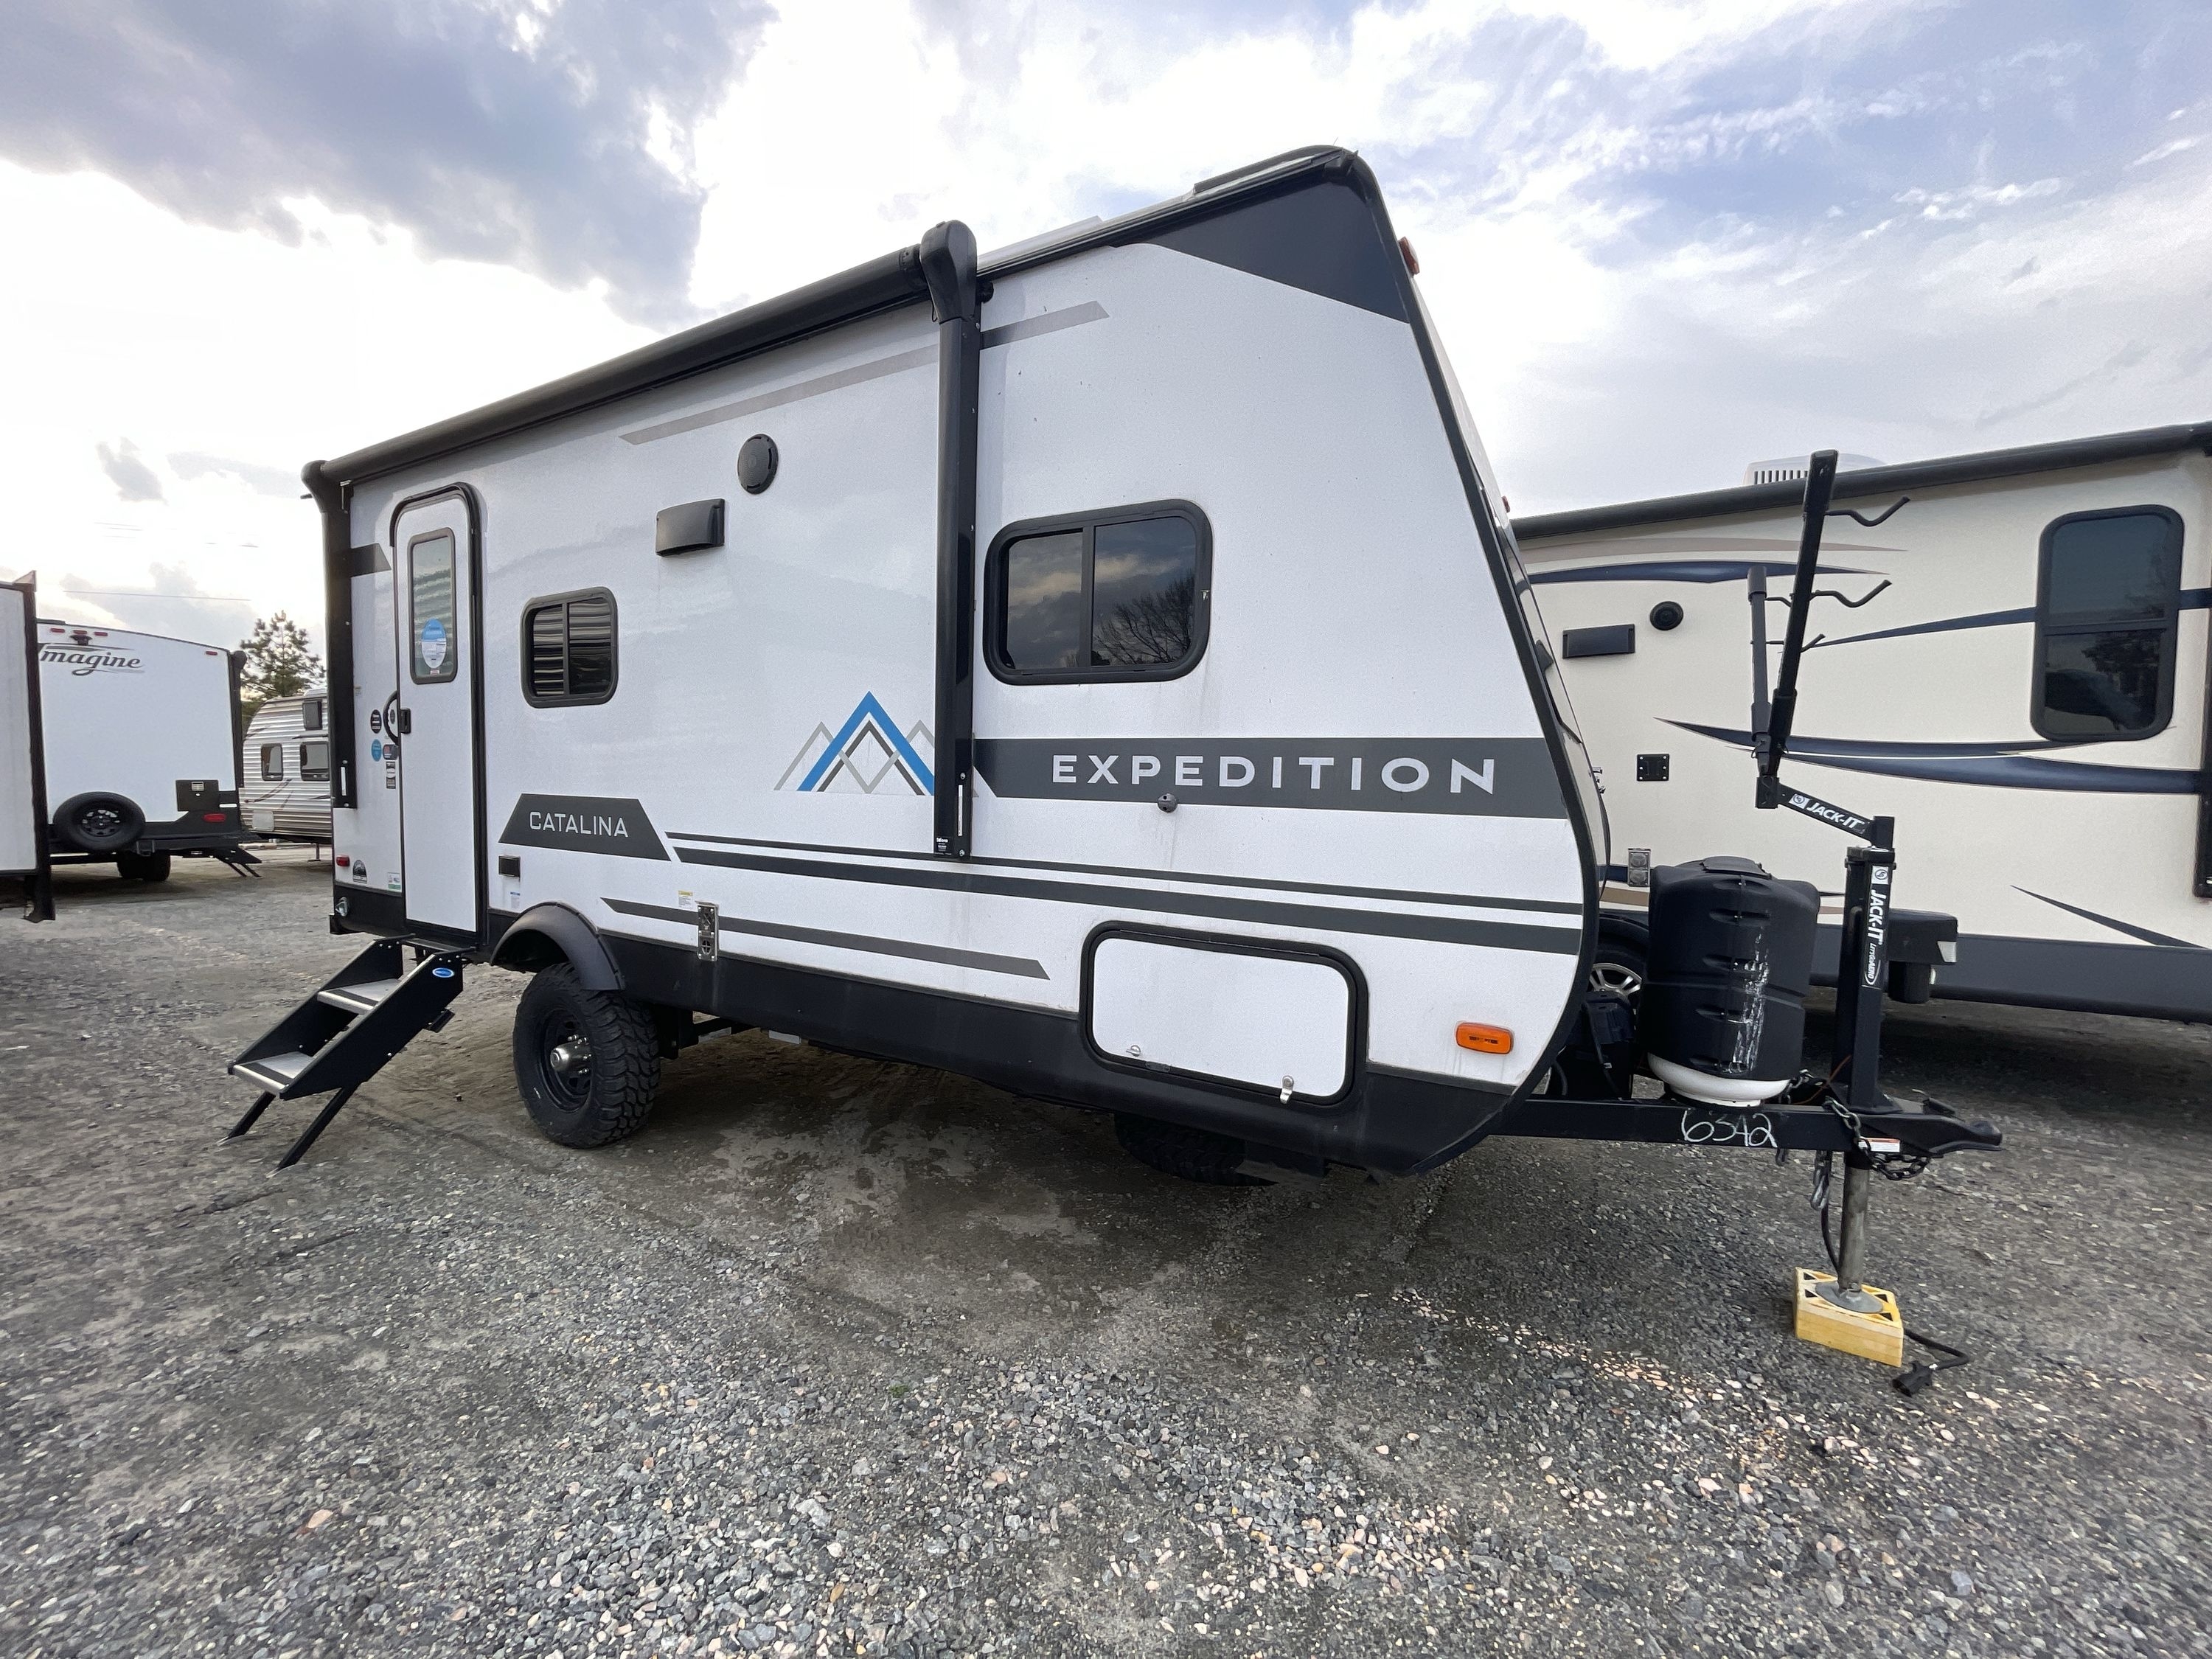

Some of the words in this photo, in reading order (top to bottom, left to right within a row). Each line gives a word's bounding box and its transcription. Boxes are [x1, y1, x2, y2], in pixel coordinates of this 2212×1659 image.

[1052, 754, 1495, 795] EXPEDITION
[529, 811, 628, 838] CATALINA
[1806, 802, 1865, 829] JACK-IT
[1868, 889, 1887, 944] JACK-IT
